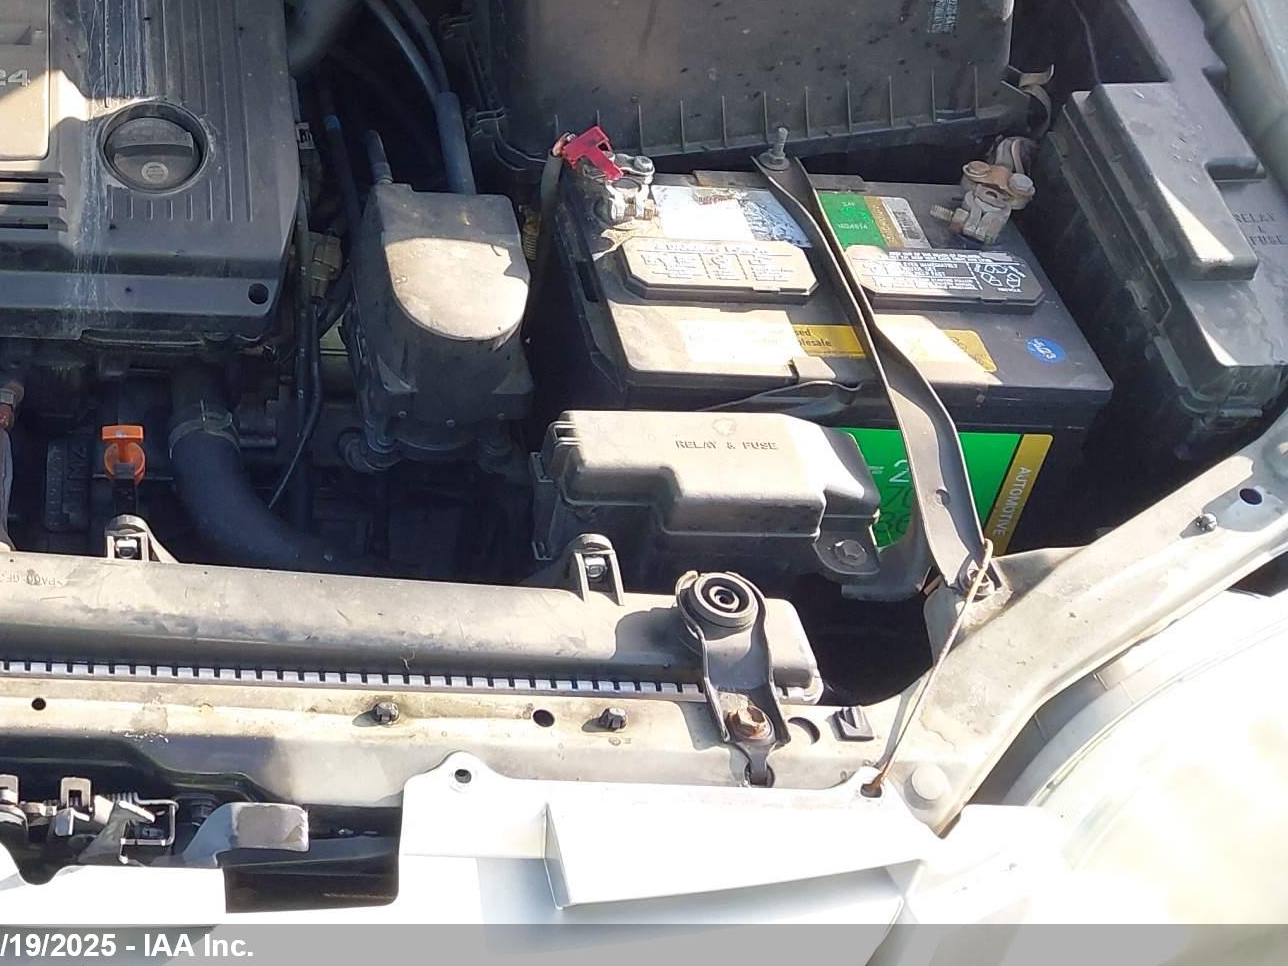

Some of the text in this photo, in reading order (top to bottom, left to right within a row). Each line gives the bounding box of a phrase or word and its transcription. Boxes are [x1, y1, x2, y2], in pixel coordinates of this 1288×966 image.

[675, 440, 718, 450] RELAY
[742, 441, 779, 450] FUSE
[993, 465, 1033, 538] AUTOMOTIVE
